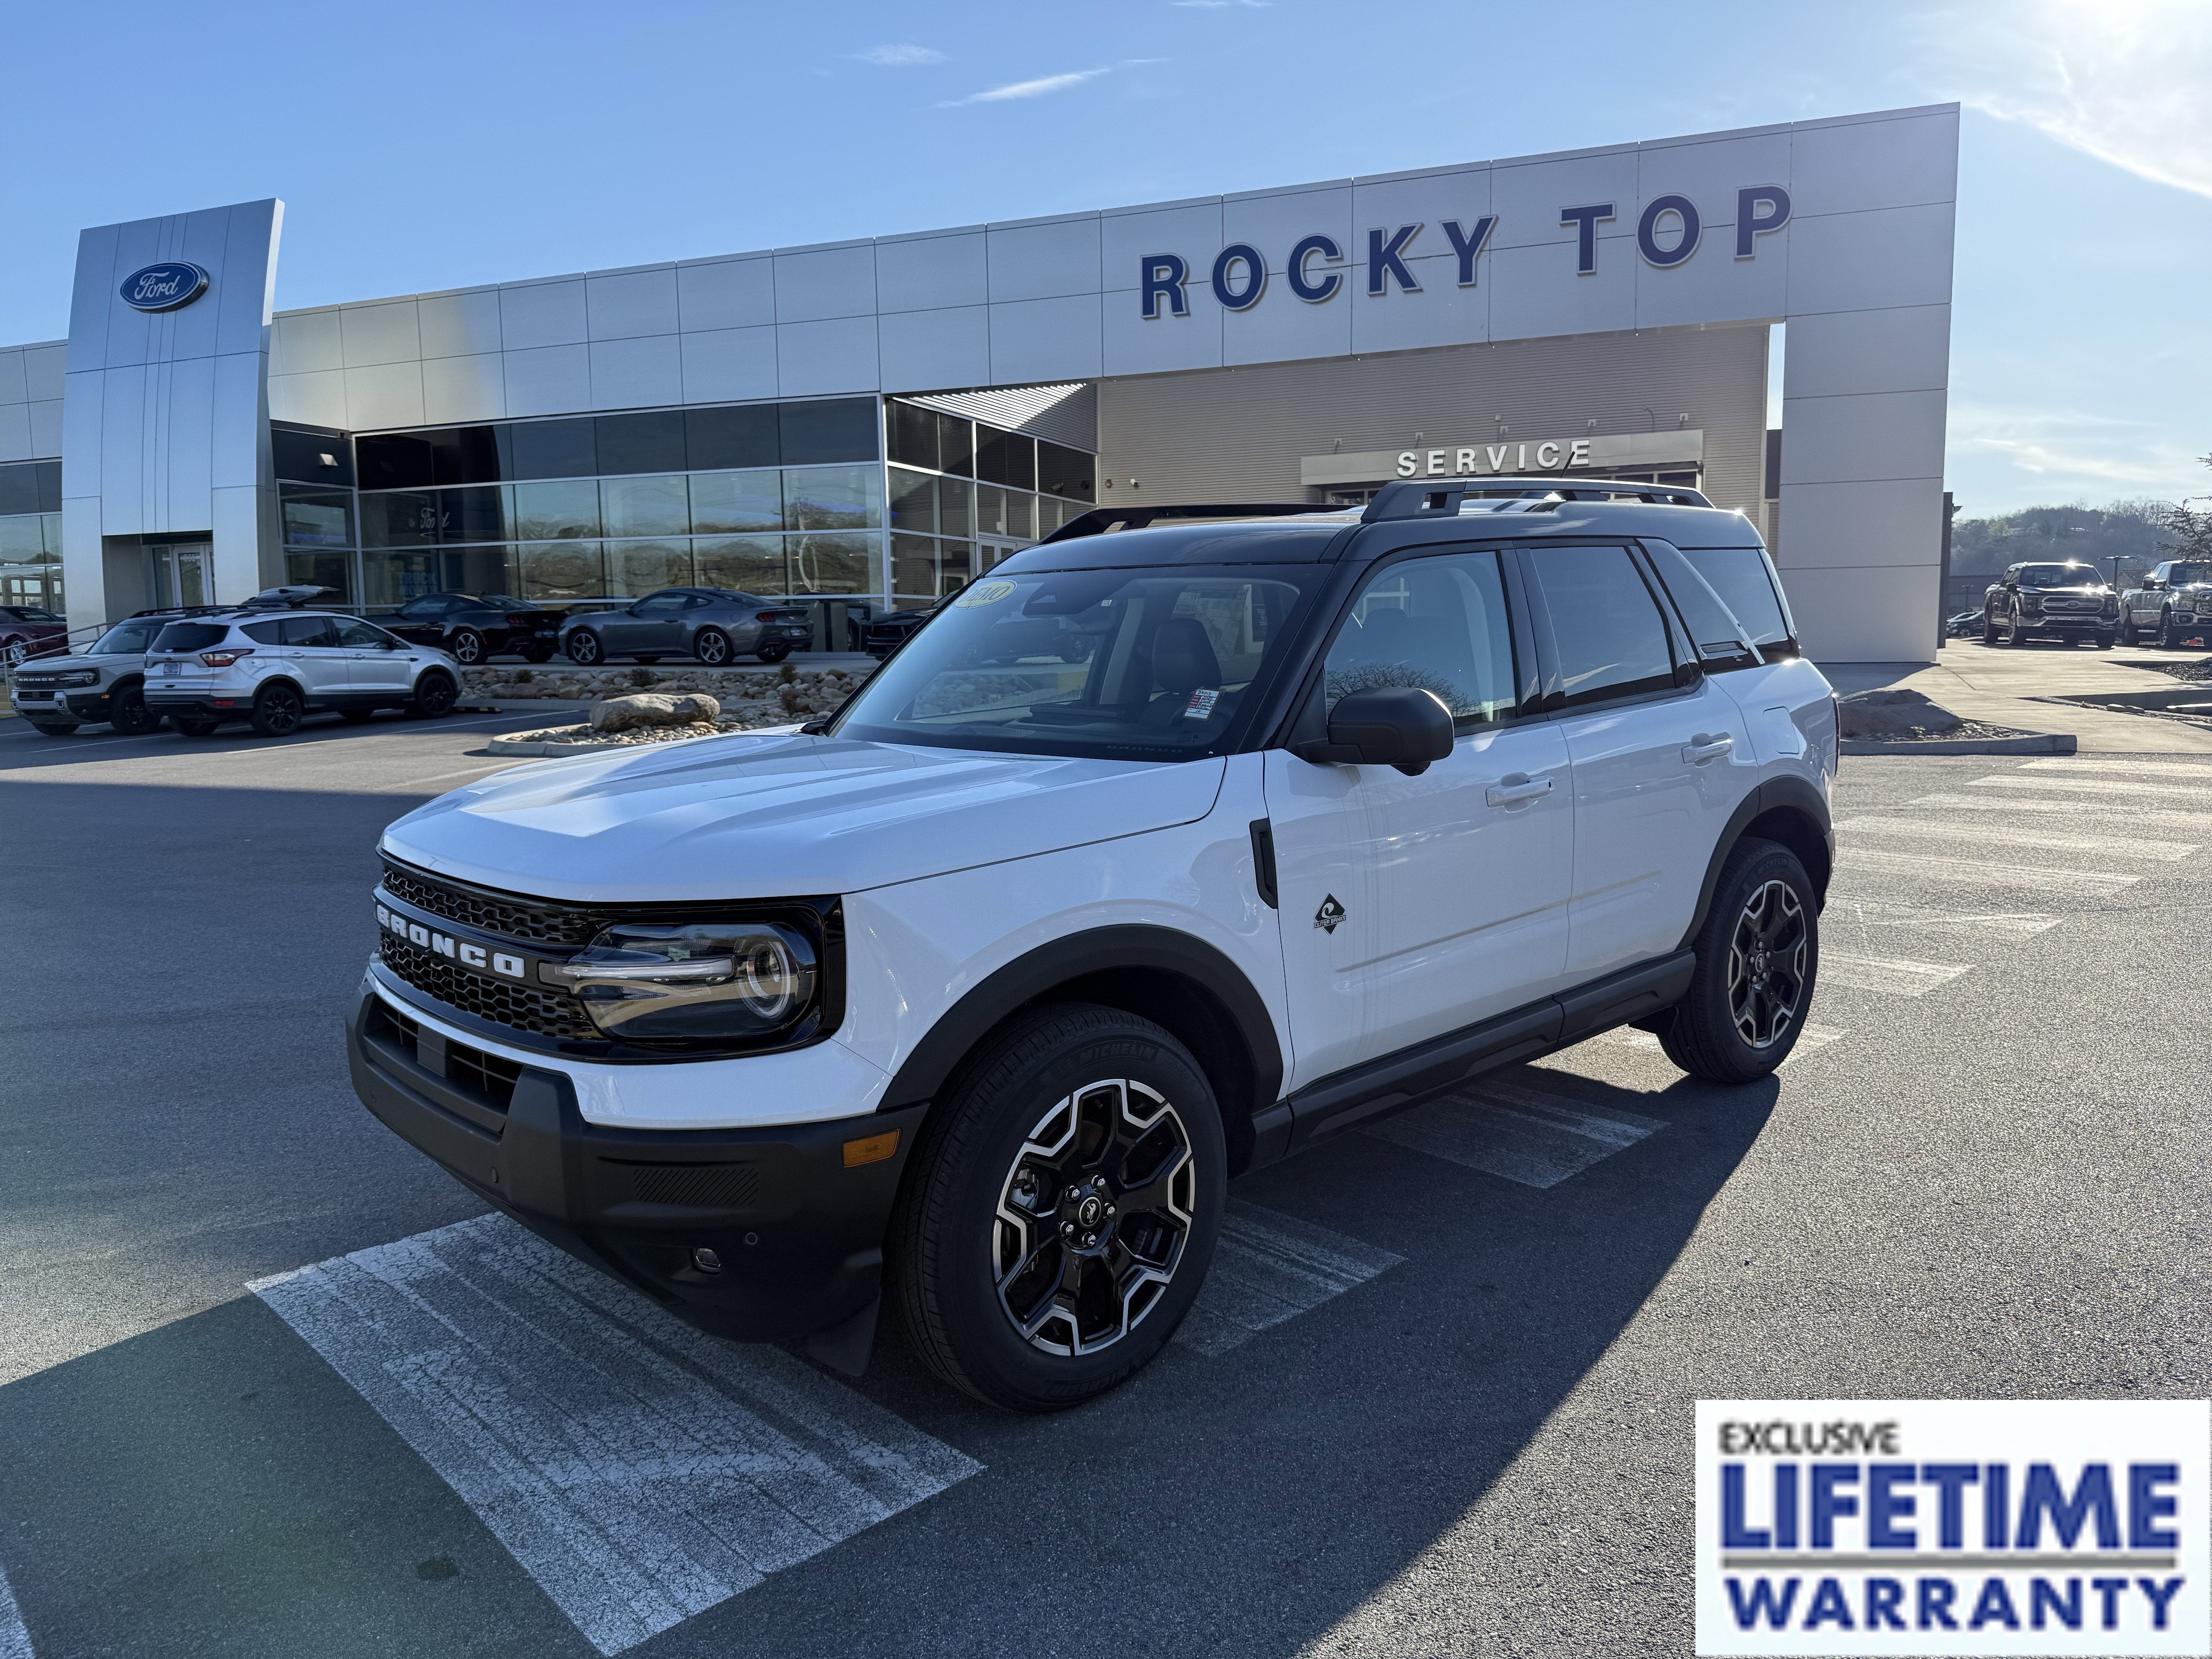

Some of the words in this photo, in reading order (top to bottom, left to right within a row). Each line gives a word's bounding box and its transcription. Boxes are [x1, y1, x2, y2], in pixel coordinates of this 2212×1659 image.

[1140, 214, 1498, 319] ROCKY
[1560, 183, 1792, 274] TOP
[134, 271, 181, 300] Ford
[1396, 440, 1590, 477] SERVICE
[958, 586, 1010, 602] DEMO
[1315, 920, 1330, 928] OUTER
[1331, 915, 1346, 924] BANKS
[374, 904, 526, 978] BRONCO
[1079, 1043, 1155, 1063] MICHELIN
